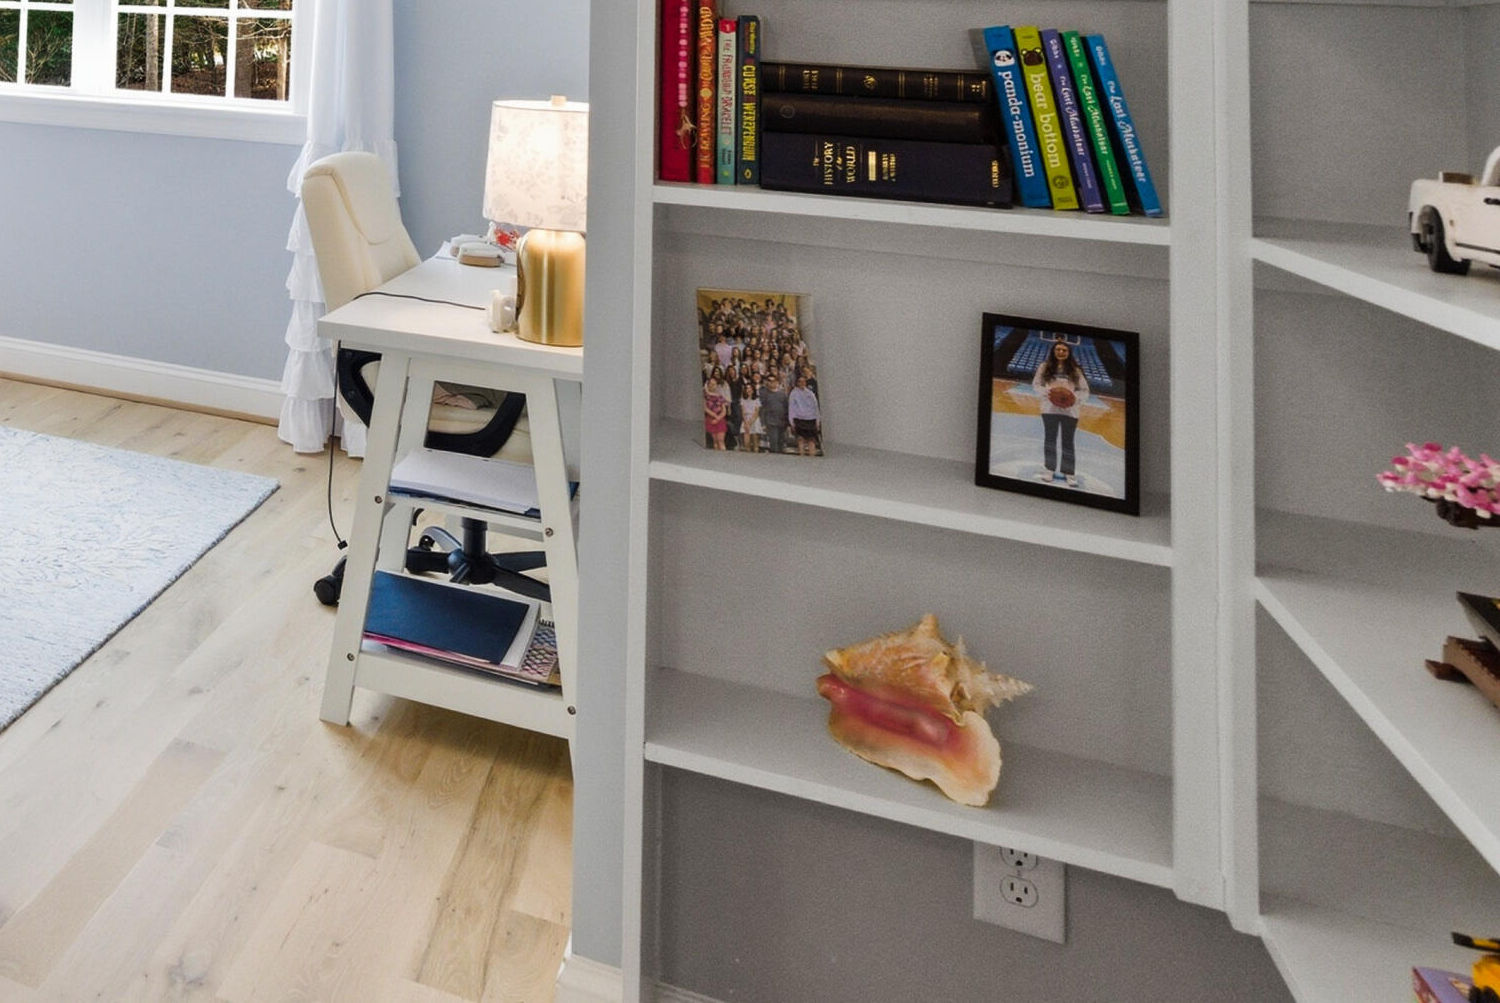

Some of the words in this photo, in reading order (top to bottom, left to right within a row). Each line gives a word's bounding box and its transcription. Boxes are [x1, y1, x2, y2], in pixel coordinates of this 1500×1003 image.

[998, 71, 1035, 178] panda-monium
[1030, 73, 1047, 110] bear
[1040, 113, 1061, 168] bottom
[823, 141, 834, 186] HISTORY
[846, 146, 856, 183] WORLD
